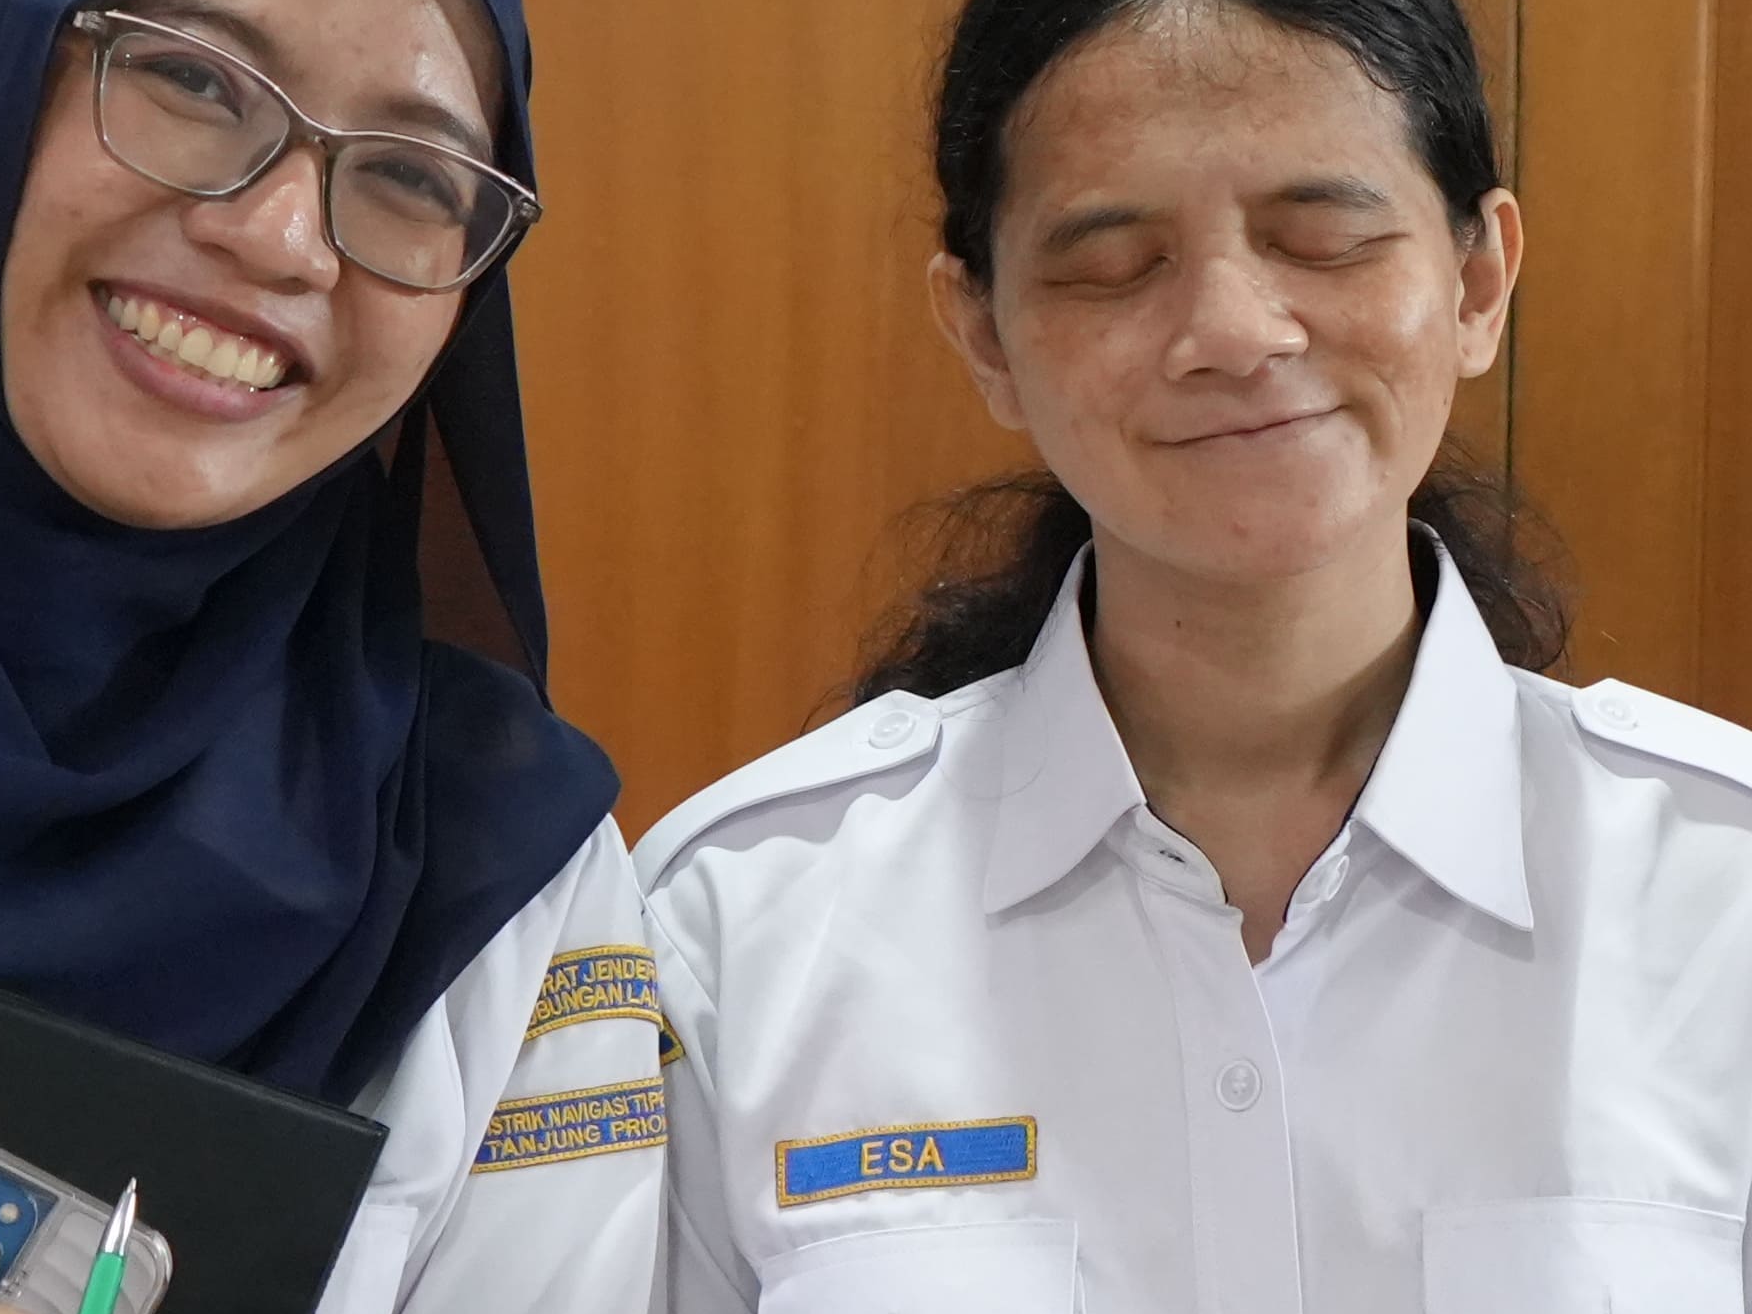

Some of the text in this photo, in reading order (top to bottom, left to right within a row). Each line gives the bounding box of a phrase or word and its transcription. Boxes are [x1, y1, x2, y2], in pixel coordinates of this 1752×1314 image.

[548, 1095, 629, 1128] NAVIGASI
[627, 1091, 665, 1114] TIP
[484, 1125, 600, 1160] TANJUNG
[861, 1136, 945, 1176] ESA
